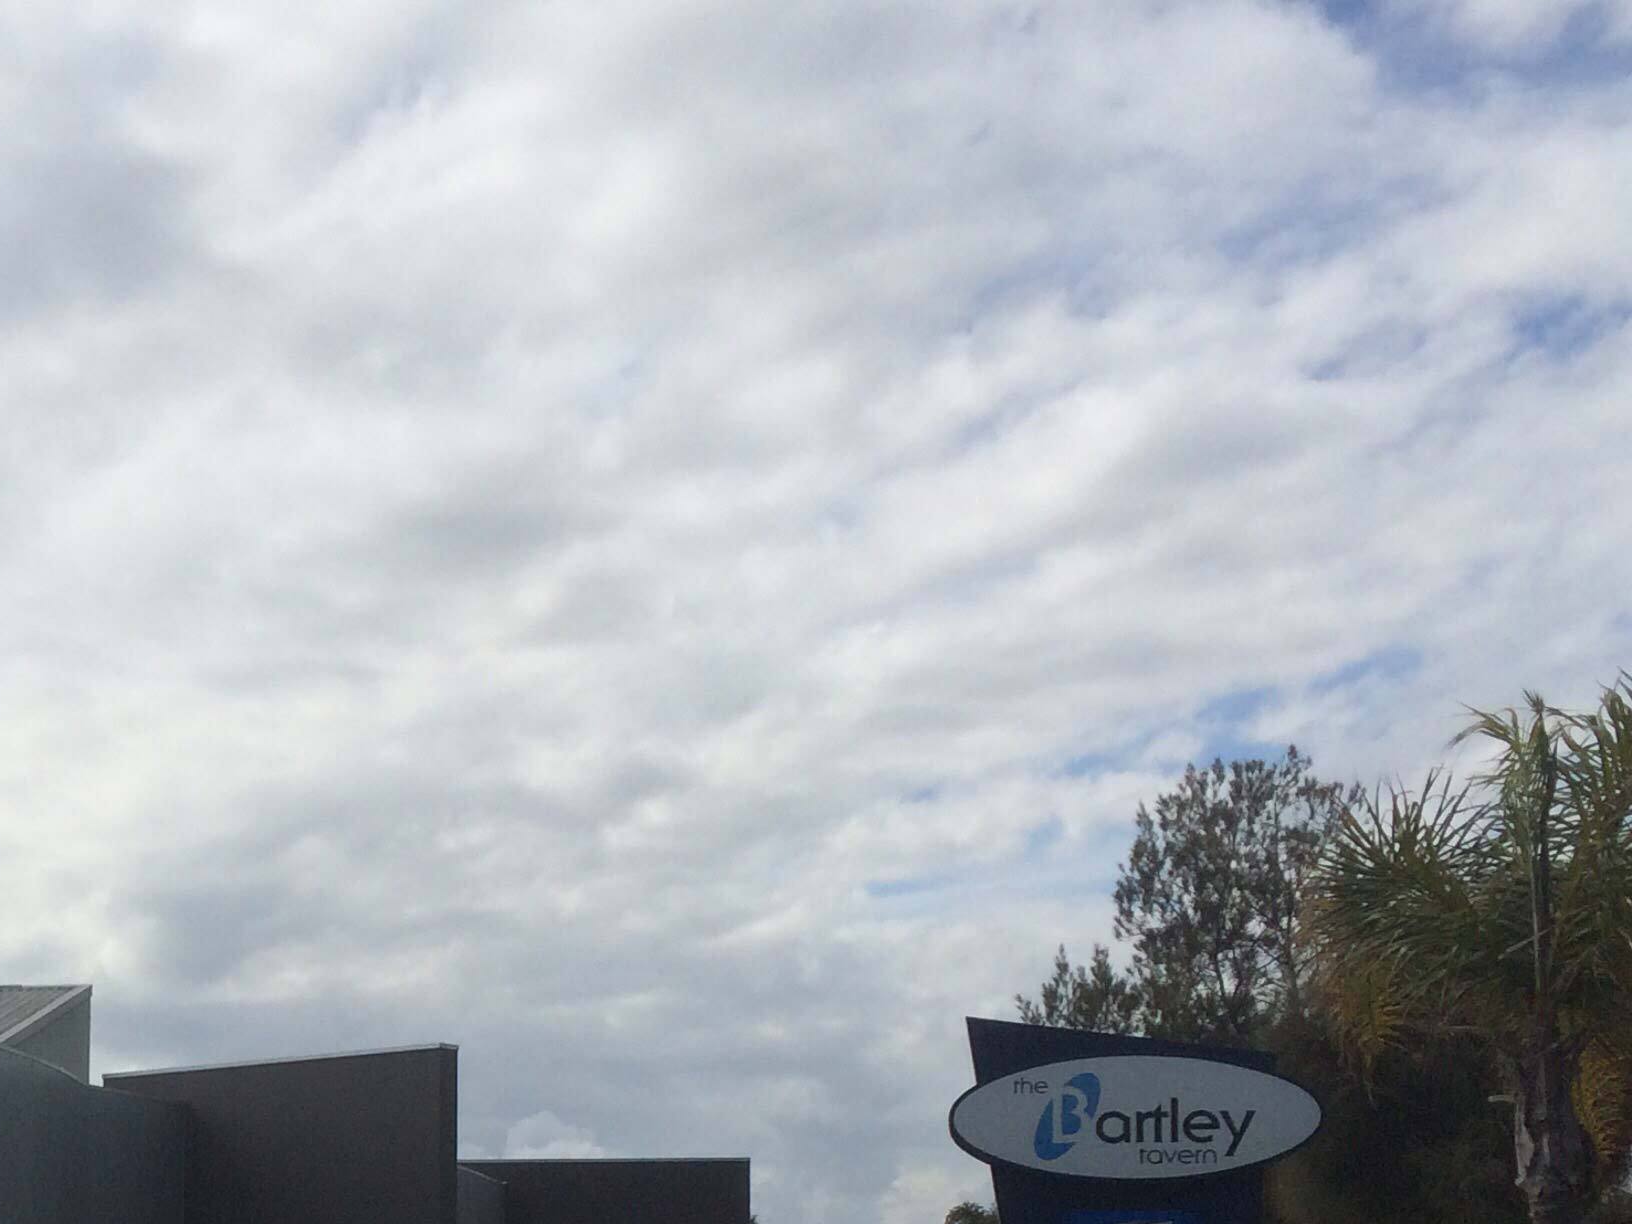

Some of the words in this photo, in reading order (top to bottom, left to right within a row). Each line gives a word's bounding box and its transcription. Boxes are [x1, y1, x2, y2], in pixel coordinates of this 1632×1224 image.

[1013, 1076, 1049, 1095] the
[1051, 1081, 1256, 1157] Bartley
[1139, 1146, 1218, 1165] tavern
